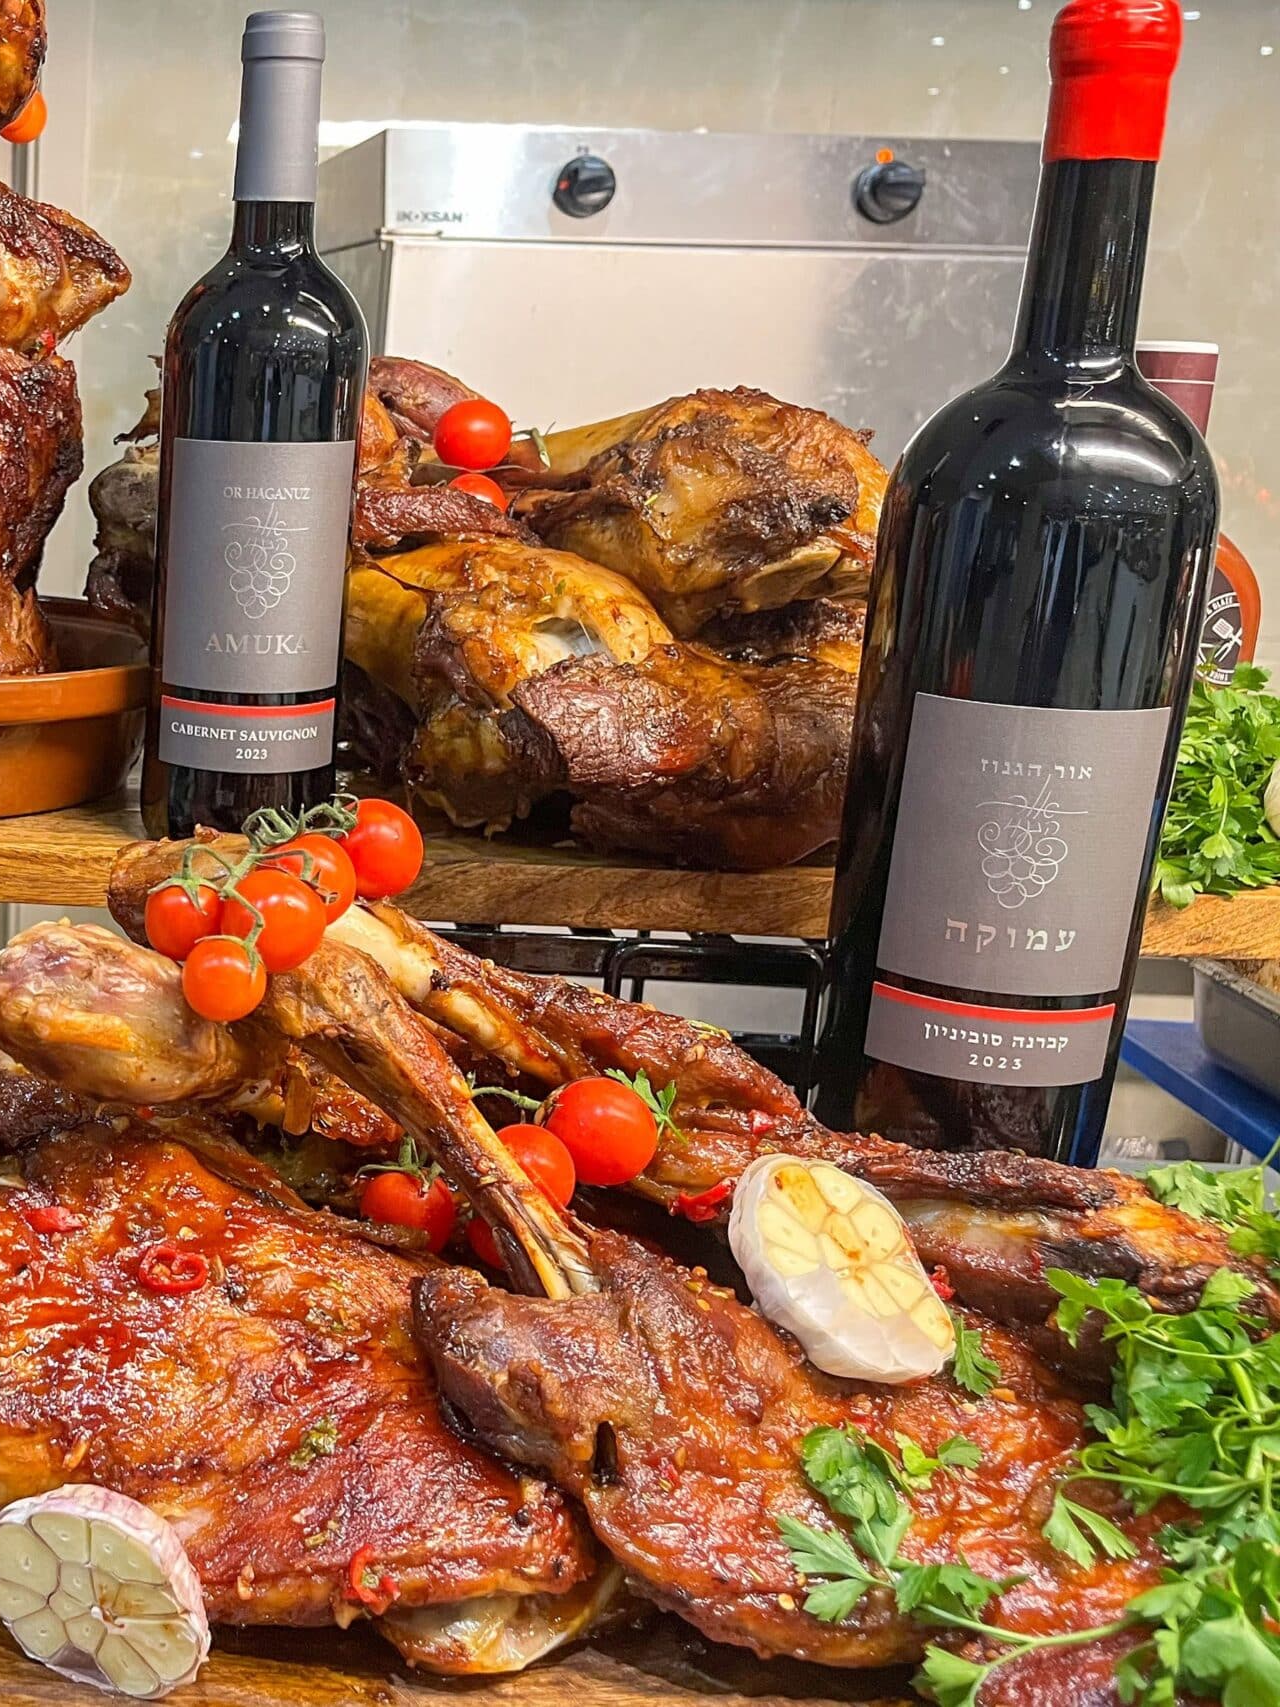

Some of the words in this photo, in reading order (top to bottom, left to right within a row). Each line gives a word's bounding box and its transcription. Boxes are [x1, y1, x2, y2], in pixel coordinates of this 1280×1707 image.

[223, 486, 242, 499] OR
[246, 487, 311, 500] HAGANUZ
[205, 632, 311, 654] AMUKA
[170, 721, 236, 741] CABERNET
[239, 726, 318, 742] SAUVIGNON
[235, 748, 268, 760] 2023
[980, 757, 1042, 778] הגנוז
[1054, 764, 1093, 780] אור
[944, 918, 1076, 953] עמוקה
[924, 1022, 1003, 1047] סוביניון
[1011, 1035, 1069, 1053] קברנה
[969, 1054, 1023, 1070] 2023
